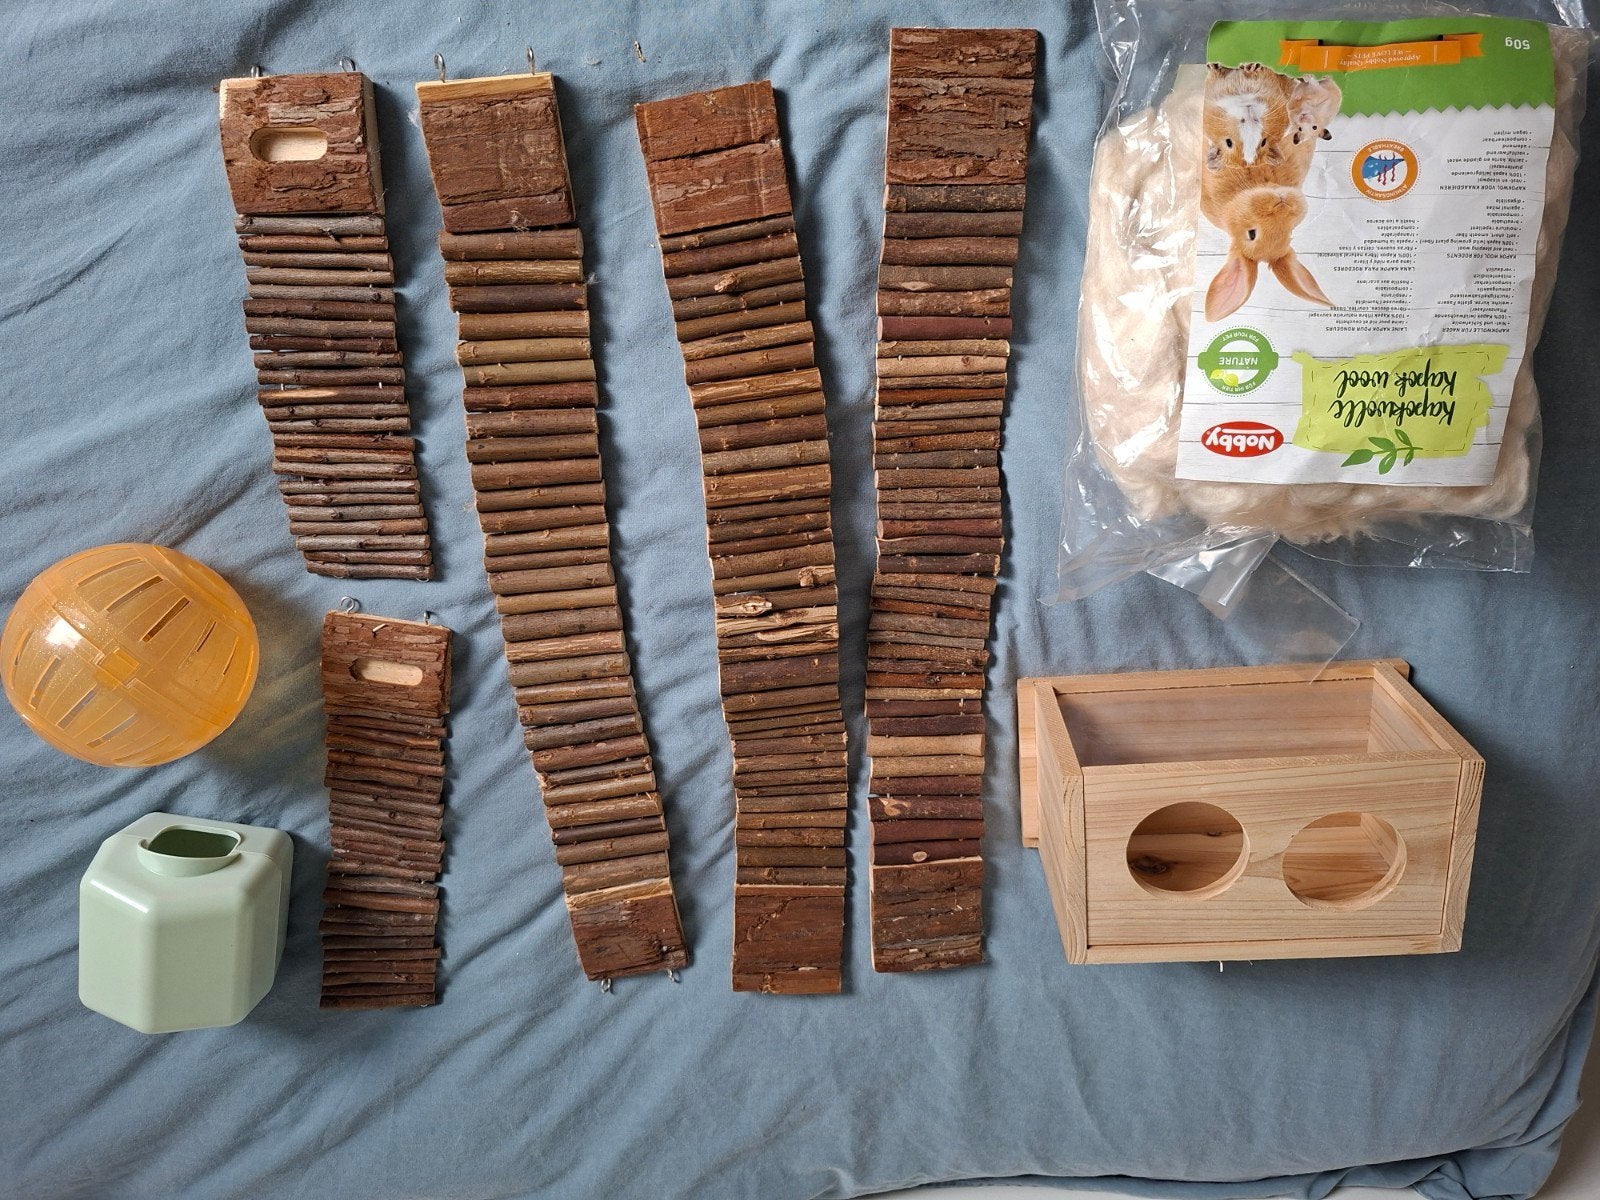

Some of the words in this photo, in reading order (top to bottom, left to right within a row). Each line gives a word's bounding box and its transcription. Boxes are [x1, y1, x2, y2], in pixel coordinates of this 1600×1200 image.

[1505, 37, 1530, 50] 50g
[1222, 332, 1232, 342] PET
[1219, 357, 1258, 365] NATURE
[1333, 371, 1389, 398] wool
[1394, 359, 1457, 398] Kapok
[1327, 388, 1455, 427] Kapokwolle
[1206, 427, 1274, 452] Nobby
